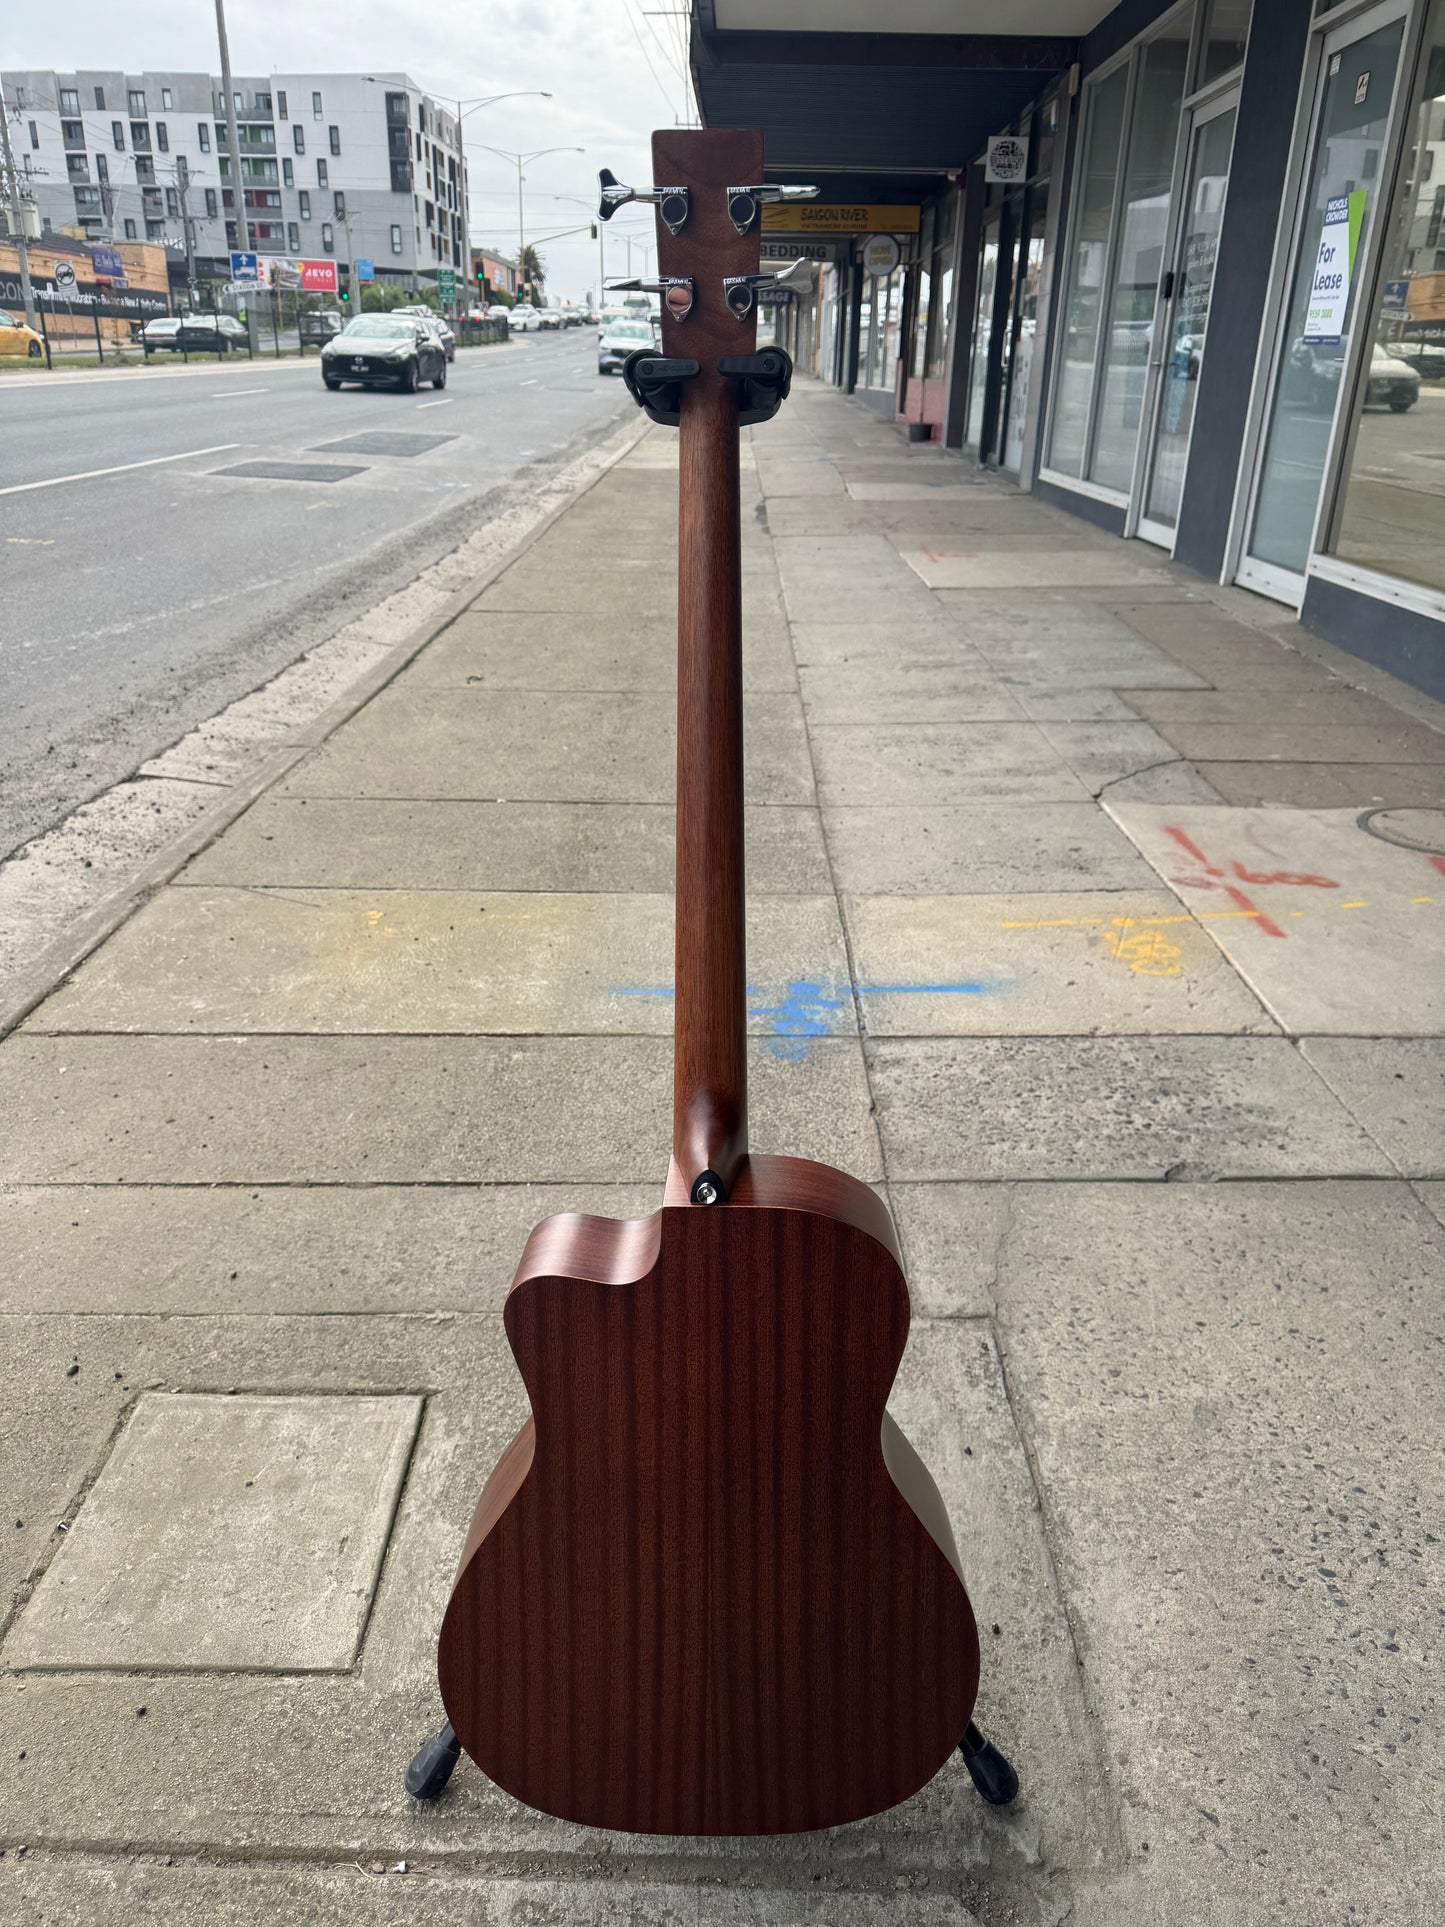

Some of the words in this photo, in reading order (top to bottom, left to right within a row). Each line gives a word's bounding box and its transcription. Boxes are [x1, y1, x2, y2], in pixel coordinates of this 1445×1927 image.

[1327, 197, 1348, 211] NICHOLS
[801, 208, 838, 221] SAIGON
[840, 208, 869, 221] RIVER
[1325, 209, 1348, 223] CROWDER
[760, 244, 827, 259] BEDDING
[1319, 242, 1336, 264] For
[1313, 269, 1343, 291] Lease
